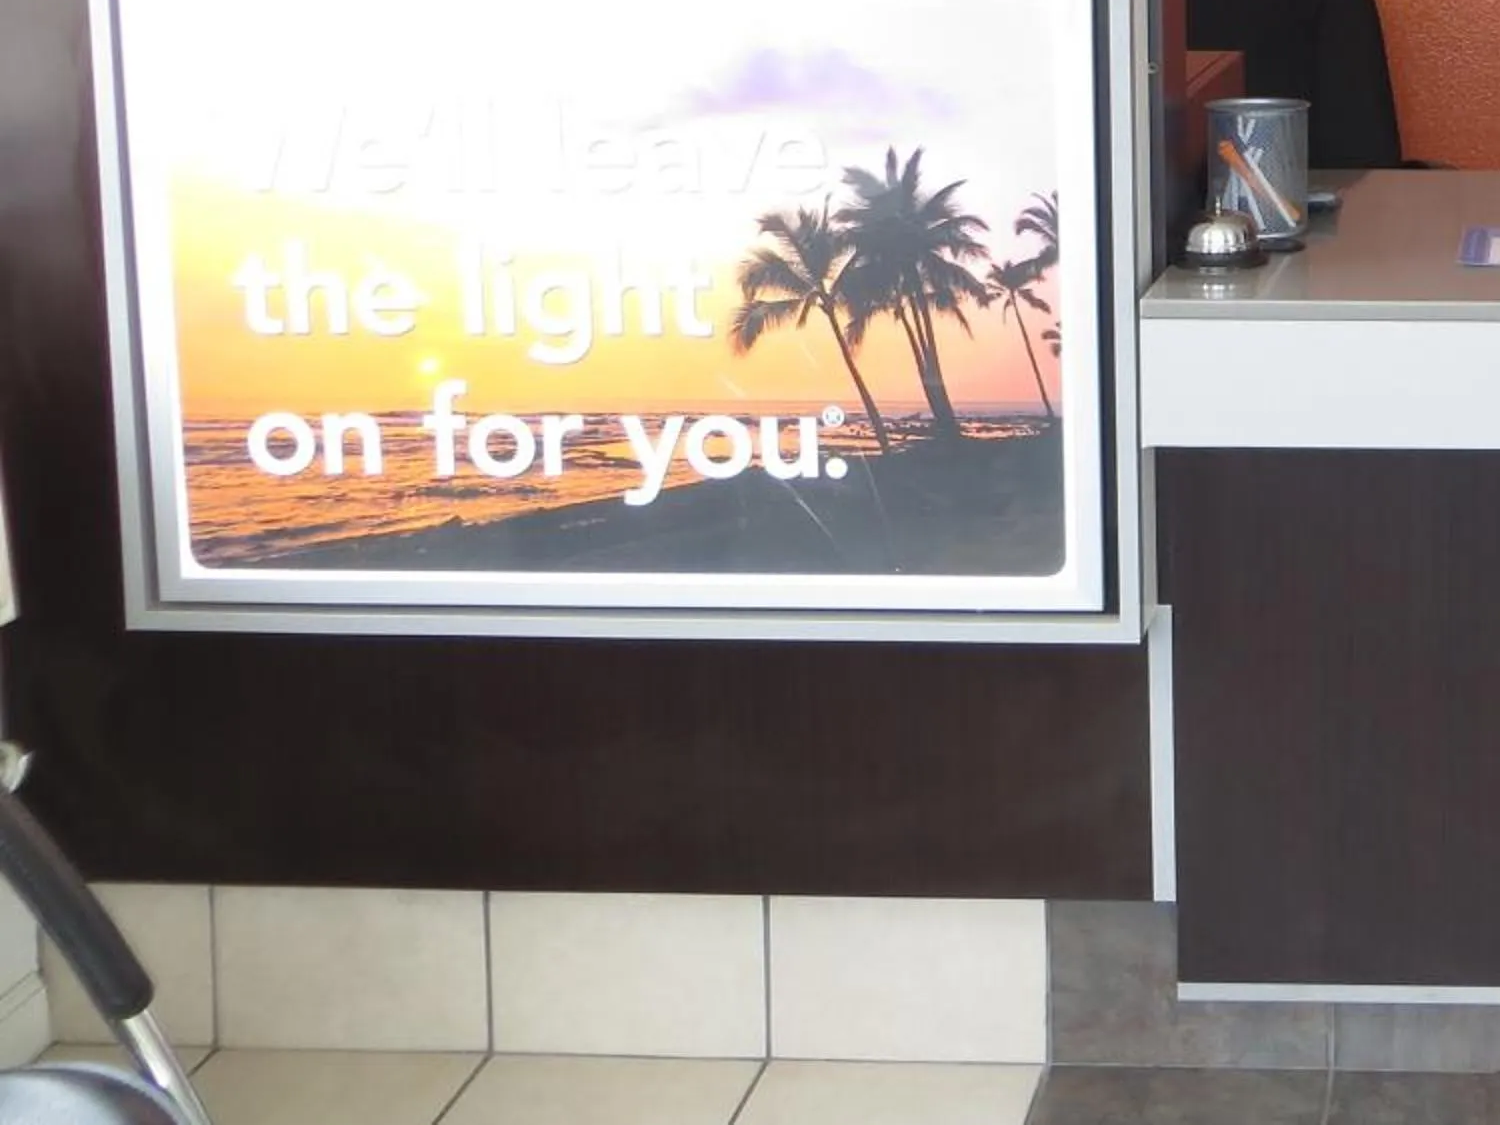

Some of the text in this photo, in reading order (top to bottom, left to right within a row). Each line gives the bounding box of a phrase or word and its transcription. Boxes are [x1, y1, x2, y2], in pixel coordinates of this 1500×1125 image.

[213, 94, 830, 194] We'll leave
[233, 238, 714, 364] the light
[247, 411, 383, 476] on
[423, 379, 583, 477] for
